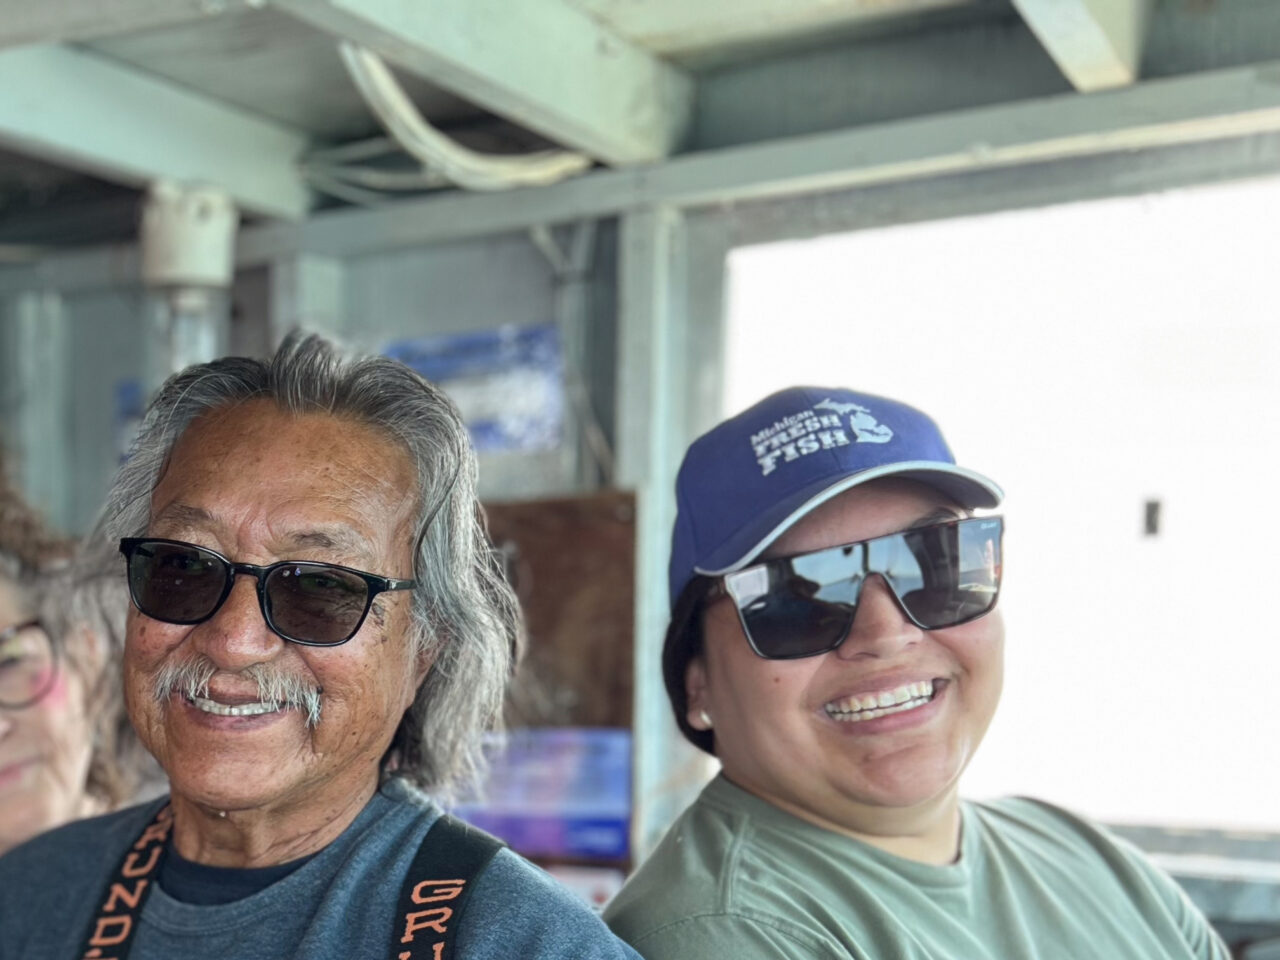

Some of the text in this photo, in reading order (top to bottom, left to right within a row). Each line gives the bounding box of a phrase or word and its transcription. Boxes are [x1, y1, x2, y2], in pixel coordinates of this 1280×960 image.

[750, 410, 815, 446] Michigan
[754, 414, 842, 457] FRESH
[757, 429, 851, 476] FISH
